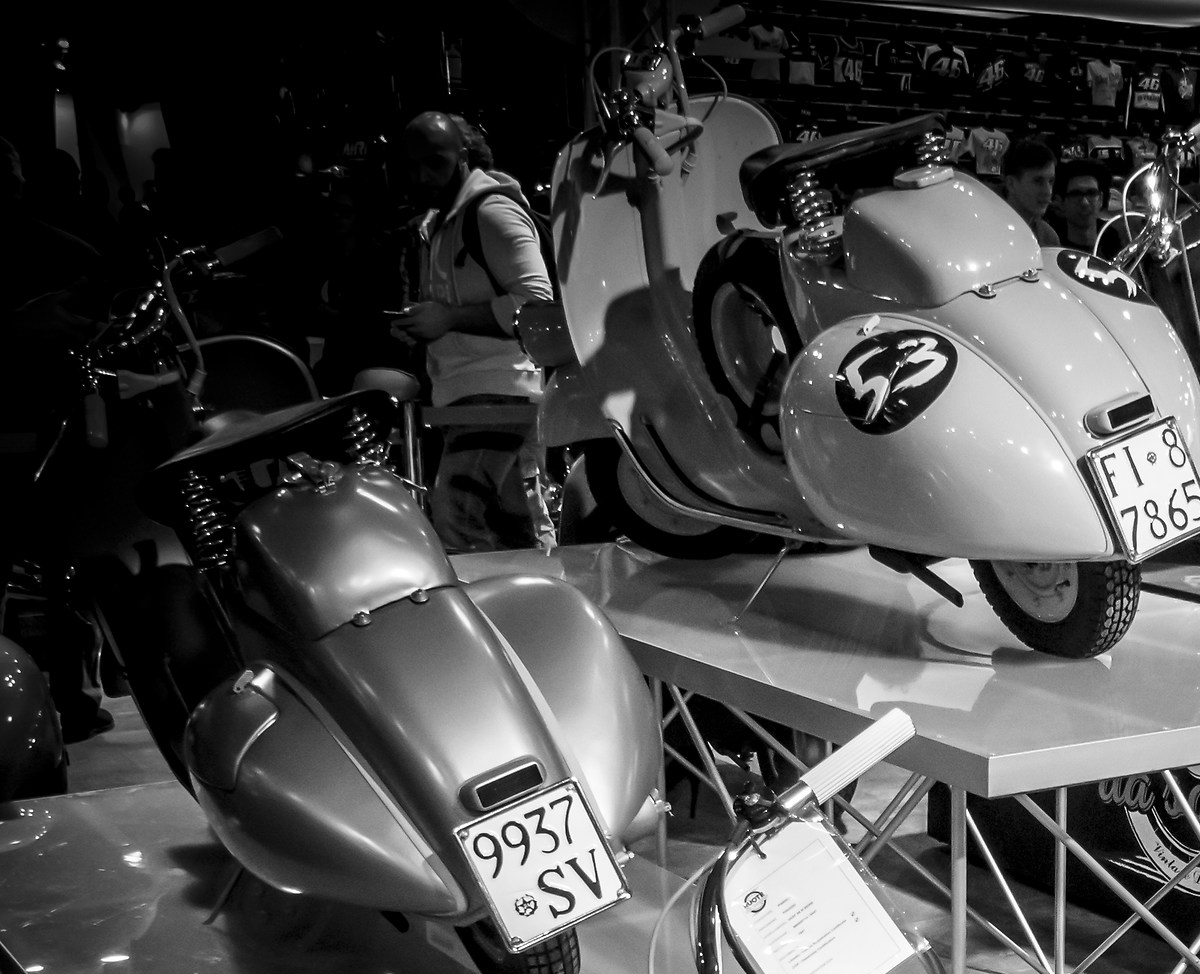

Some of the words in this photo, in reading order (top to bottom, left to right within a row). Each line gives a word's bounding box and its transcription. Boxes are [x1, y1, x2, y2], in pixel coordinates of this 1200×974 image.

[931, 56, 963, 79] 46
[1138, 77, 1160, 90] 46
[1100, 446, 1143, 499] FI
[1161, 428, 1186, 468] 8
[473, 795, 573, 879] 9937
[538, 848, 602, 919] SV
